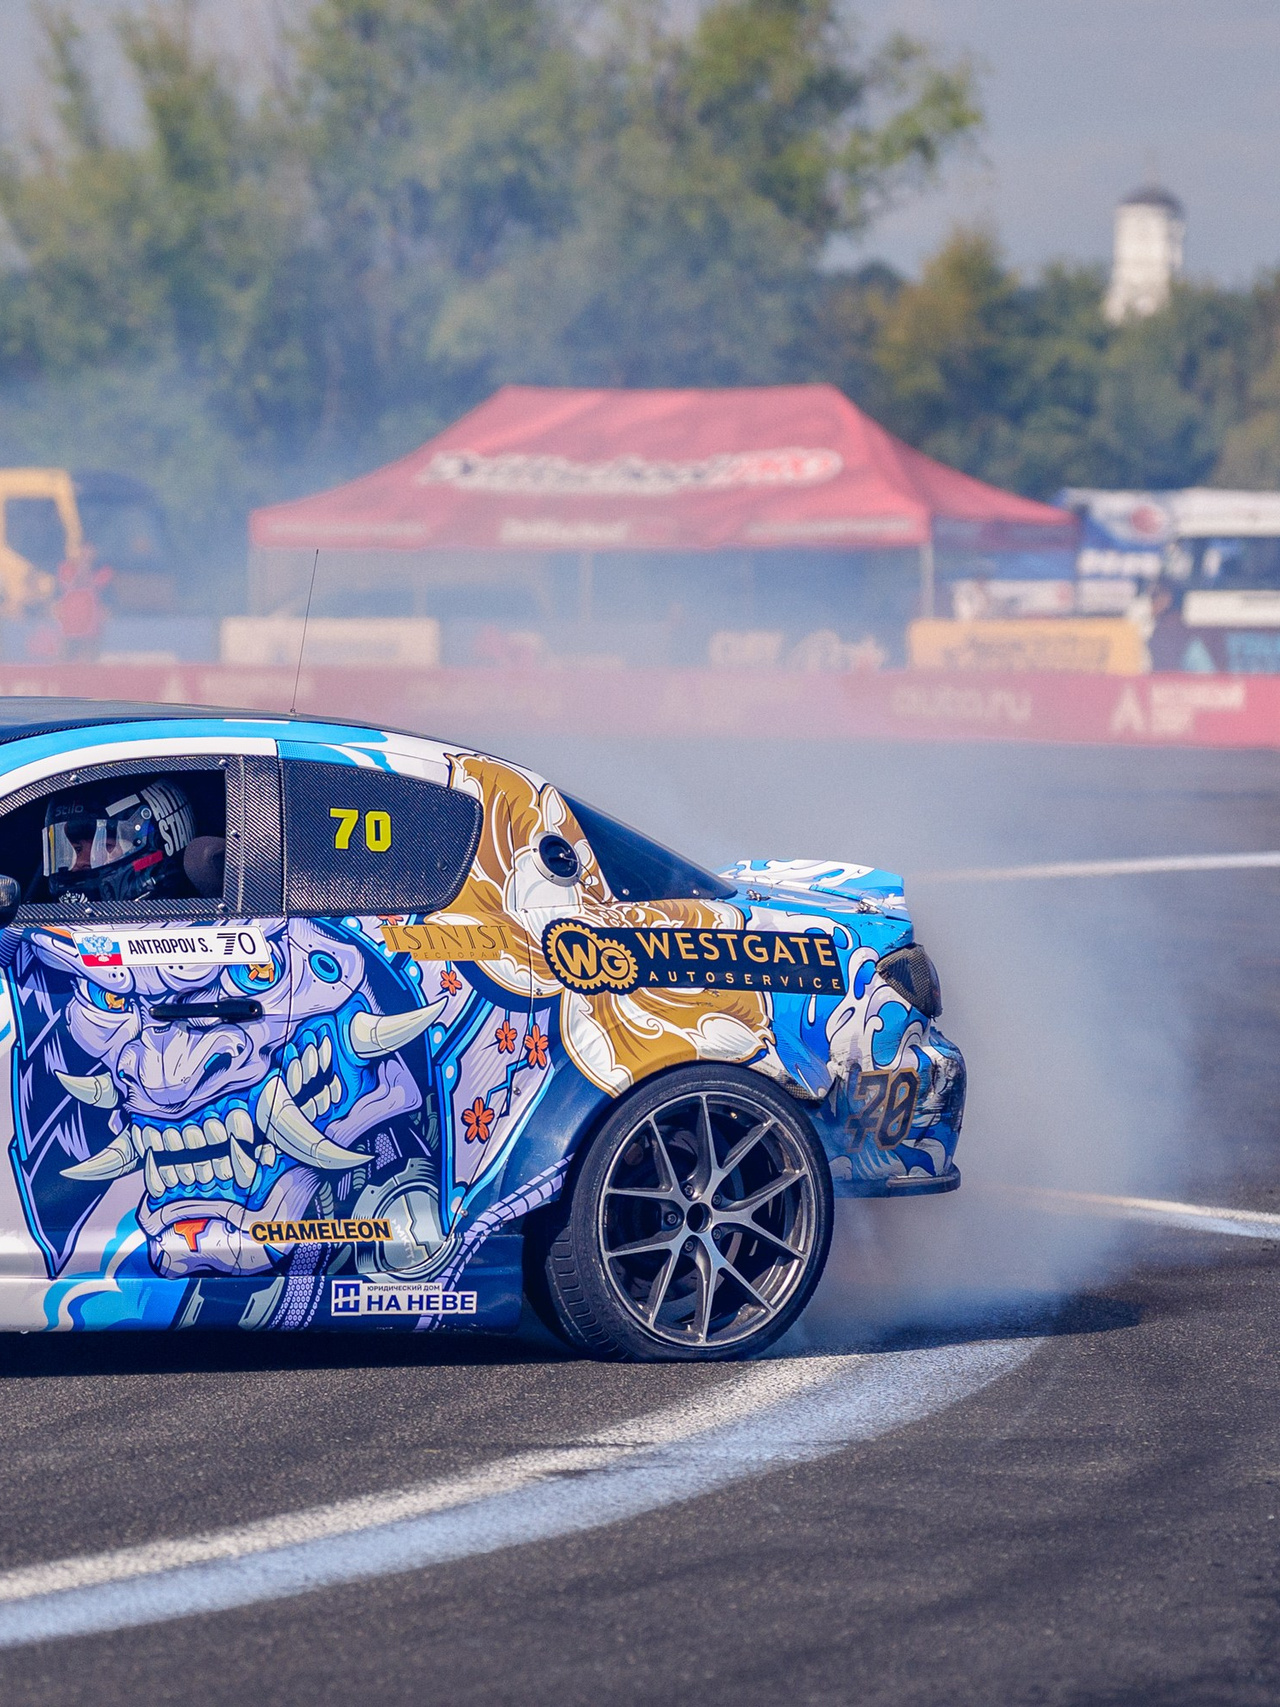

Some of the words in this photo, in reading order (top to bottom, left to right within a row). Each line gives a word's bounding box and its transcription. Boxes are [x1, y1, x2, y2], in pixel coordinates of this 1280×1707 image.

[329, 808, 392, 852] 70
[127, 938, 199, 955] ANTROPOV
[199, 938, 213, 954] S.
[217, 932, 256, 955] 70
[634, 931, 838, 967] WESTGATE
[649, 970, 842, 990] AUTOSERVICE
[845, 1067, 920, 1153] 70
[251, 1221, 392, 1242] CHAMELEON
[367, 1295, 402, 1311] НА
[408, 1294, 475, 1311] НЕВЕ
